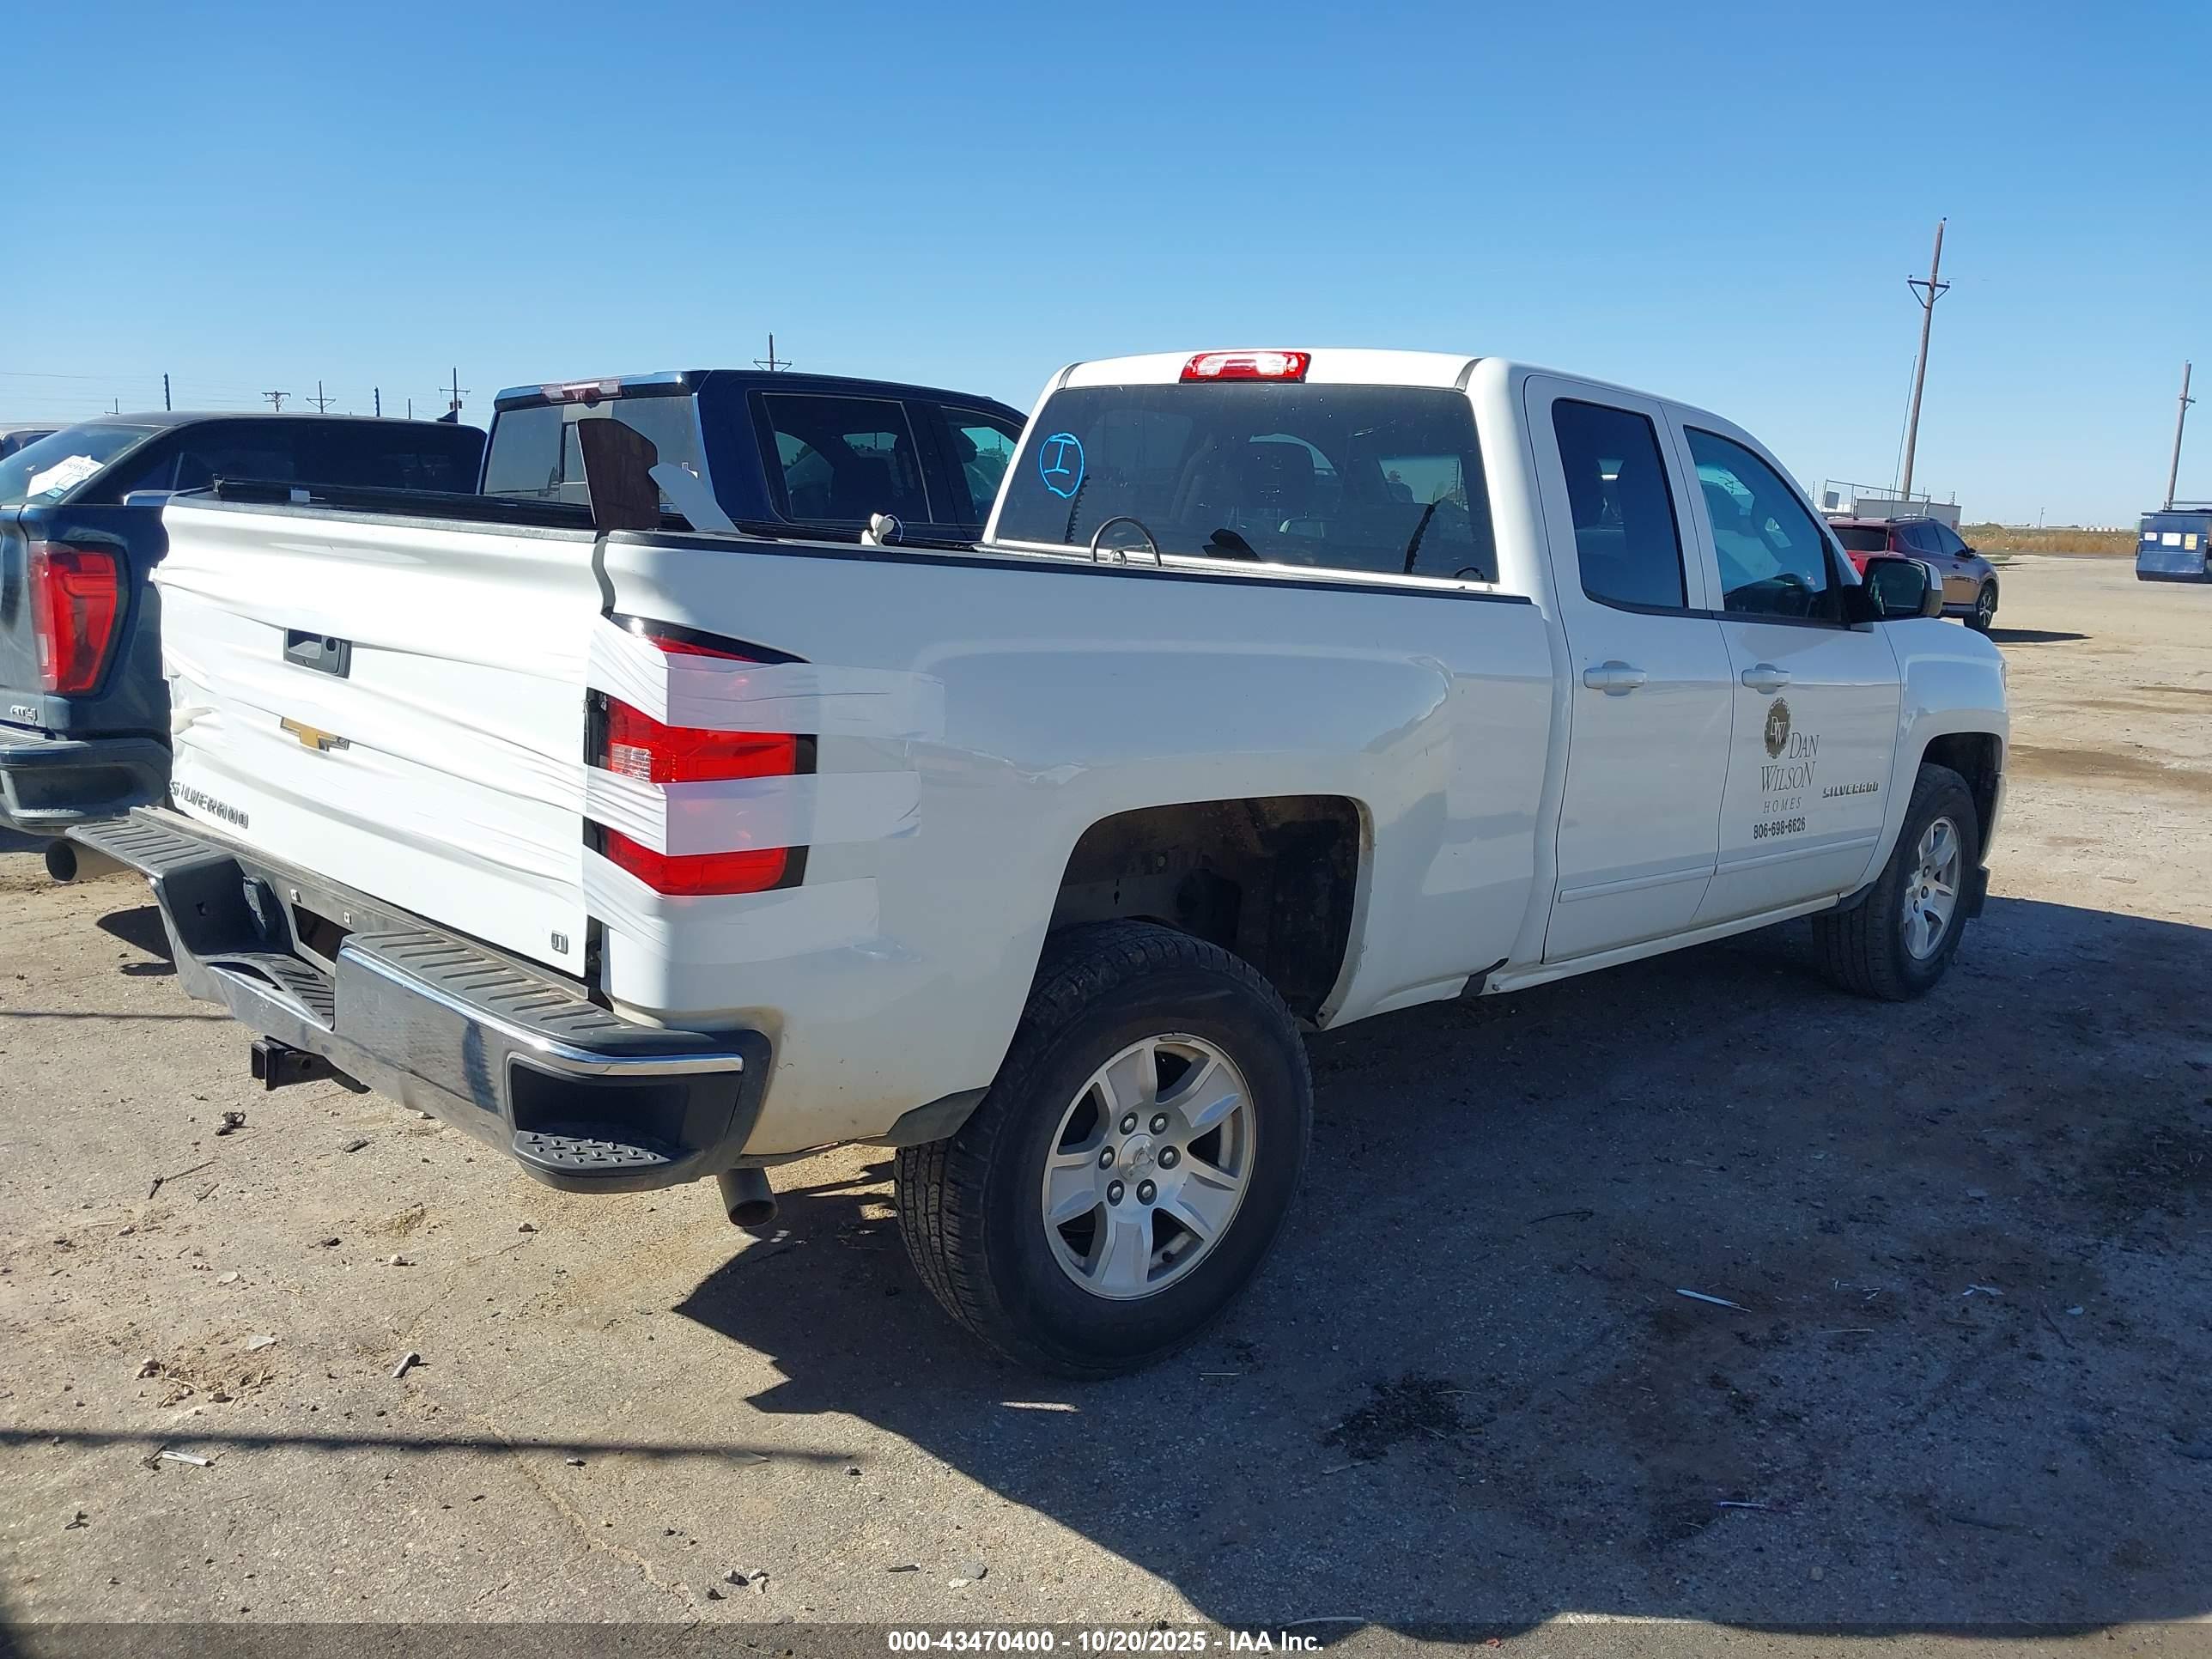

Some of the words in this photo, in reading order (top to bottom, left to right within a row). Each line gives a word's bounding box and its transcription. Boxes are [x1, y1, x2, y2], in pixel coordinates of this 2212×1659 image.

[1789, 732, 1820, 760] DAN
[1761, 761, 1817, 793] WILSON
[1821, 782, 1879, 799] SILVERADO
[171, 781, 249, 830] SILVERADO
[1763, 797, 1802, 814] HOMES
[1753, 817, 1806, 840] 806-698-6626
